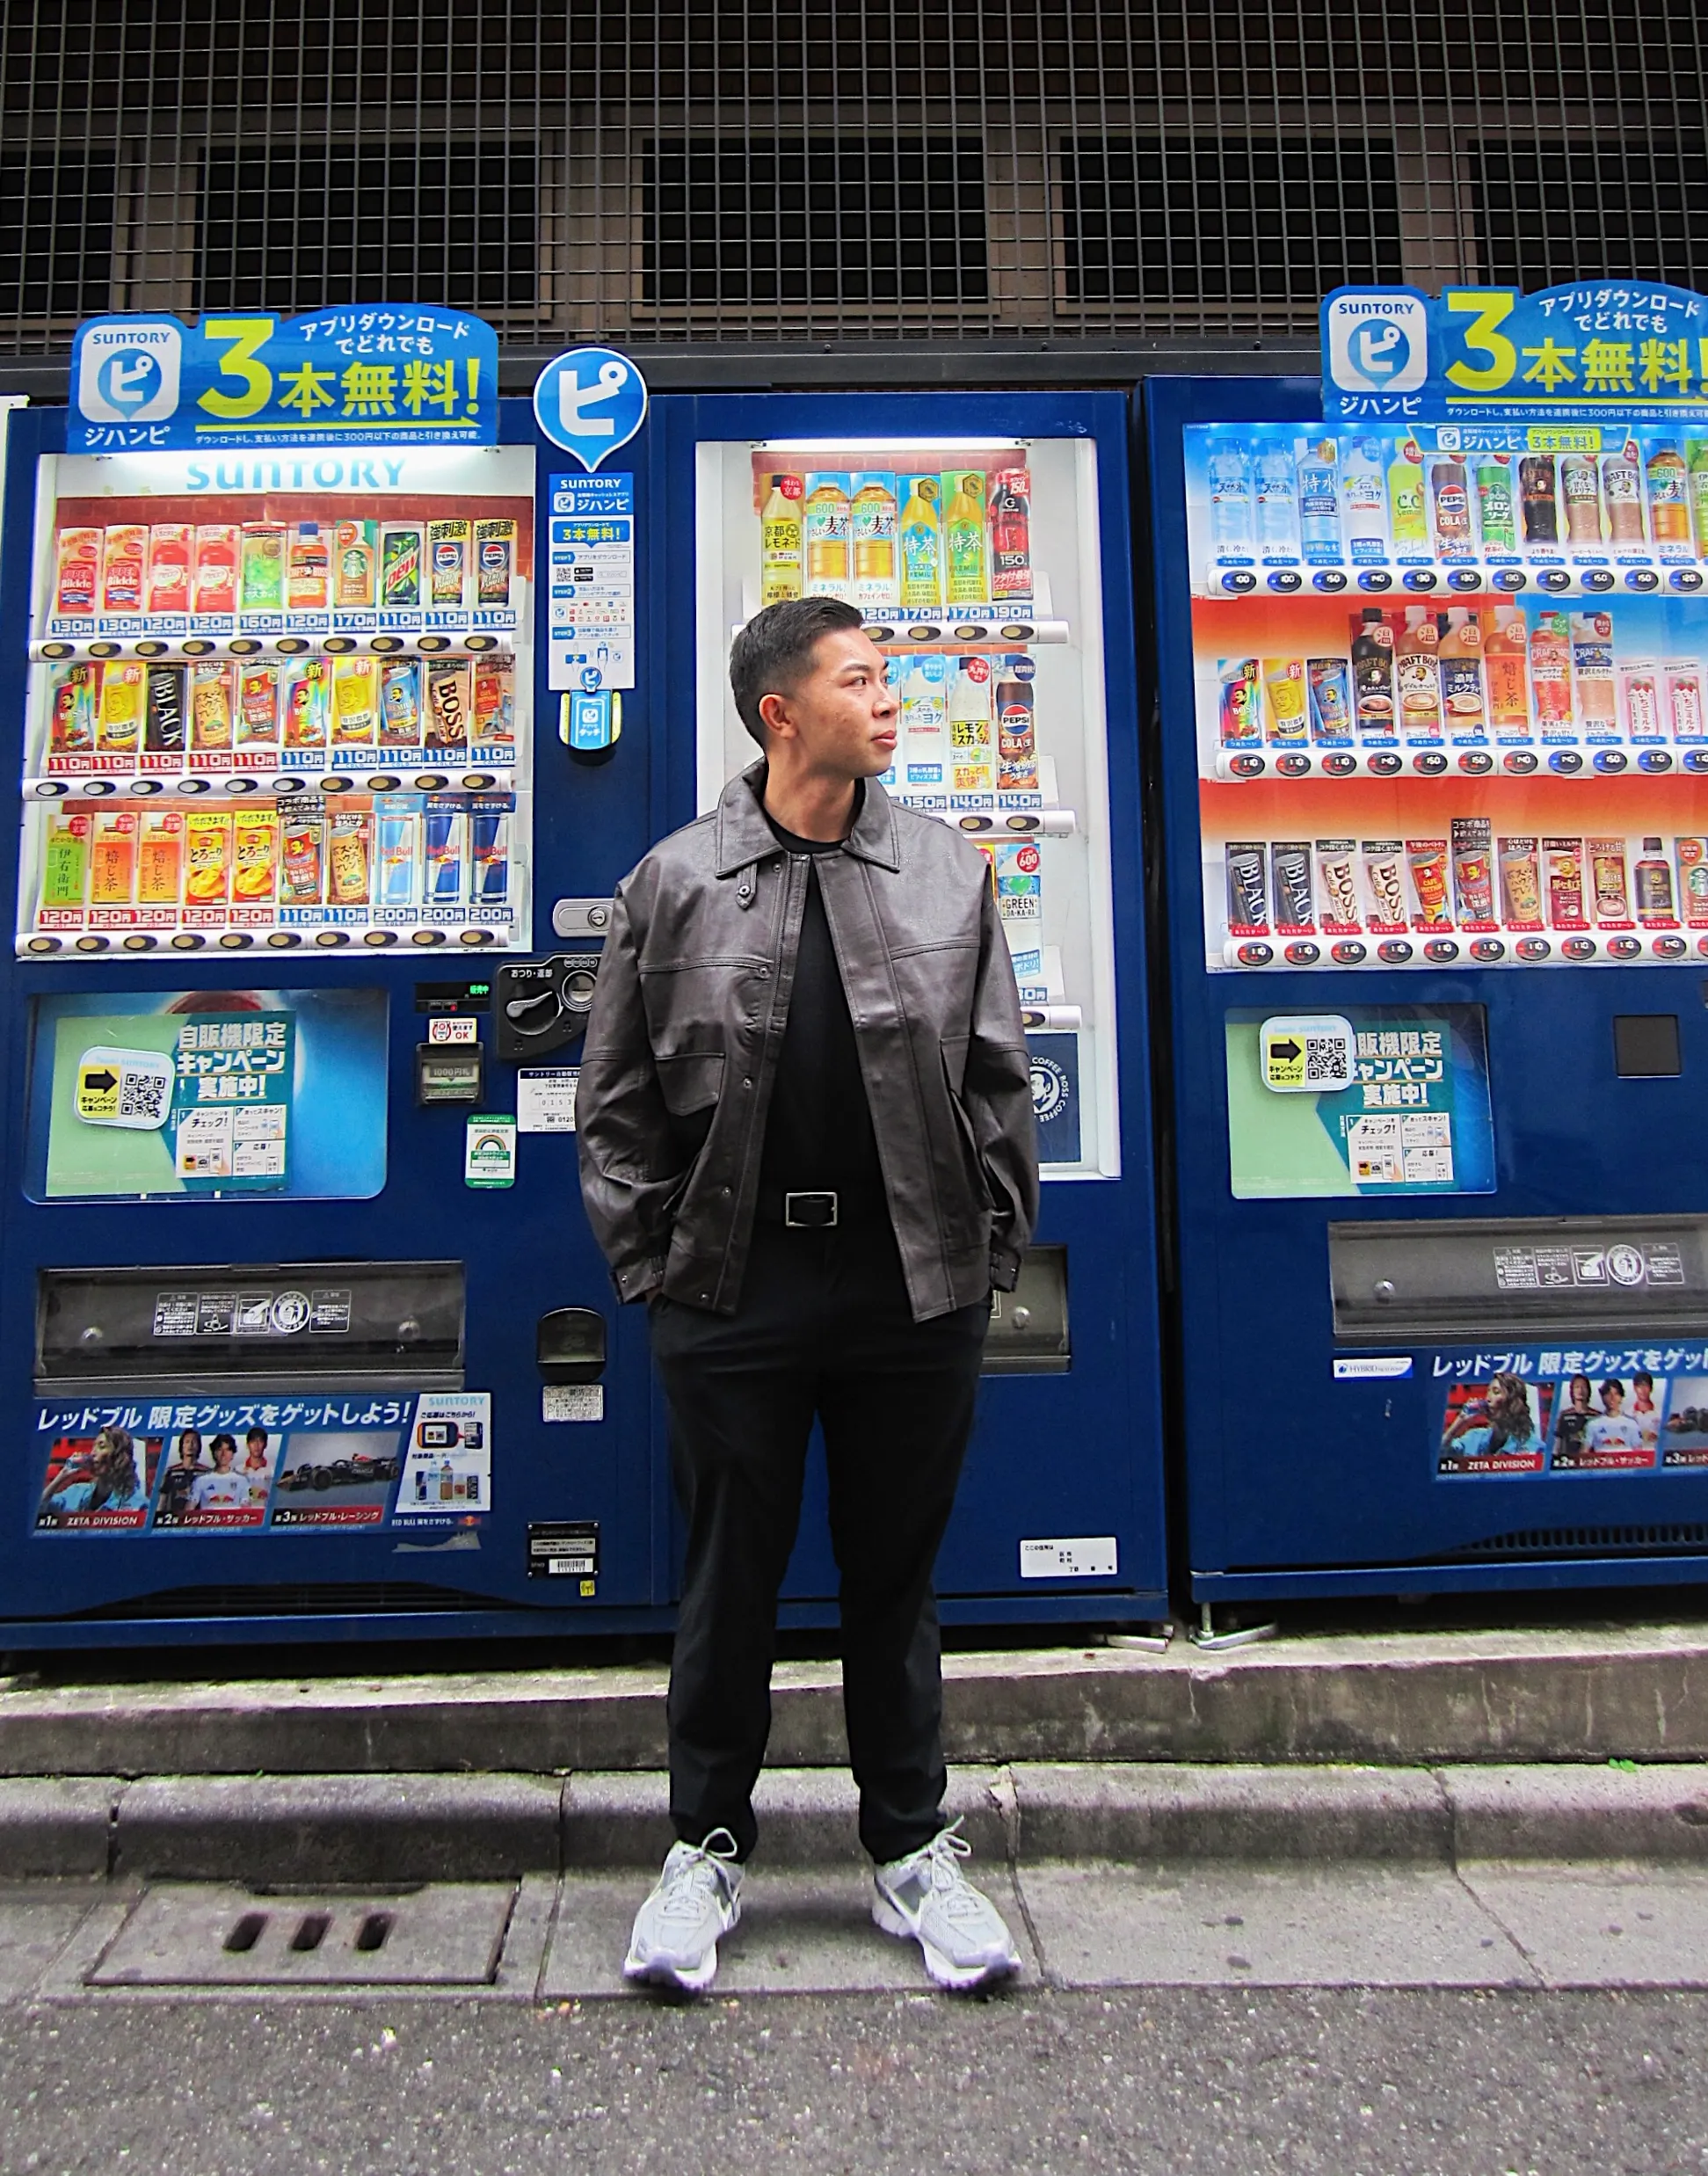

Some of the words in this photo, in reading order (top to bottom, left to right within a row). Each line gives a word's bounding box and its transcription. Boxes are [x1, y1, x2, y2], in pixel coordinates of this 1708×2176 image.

[1339, 302, 1414, 315] SUNTORY
[1539, 289, 1700, 318] アプリダウンロード
[300, 313, 470, 341] アプリダウンロード
[1574, 315, 1668, 333] でどれでも
[92, 331, 171, 346] SUNTORY
[335, 336, 434, 355] でどれでも
[1360, 326, 1399, 371] ピ
[112, 356, 153, 401] ピ
[559, 361, 628, 436] ピ
[1340, 397, 1422, 415] ジハンピ
[84, 426, 171, 447] ジハンピ
[1464, 435, 1520, 449] ジハンピ
[1532, 435, 1595, 450] 3本無料!
[187, 458, 406, 491] SUNTORY
[1657, 468, 1676, 478] 600
[561, 479, 621, 489] SUNTORY
[1303, 474, 1336, 492] 特水
[577, 499, 629, 511] ジハンピ
[815, 504, 834, 513] 600
[861, 503, 877, 513] 600
[1485, 501, 1510, 512] メロン
[1440, 516, 1461, 526] COLA
[563, 528, 621, 541] 3本無料!
[765, 526, 784, 537] 京都
[765, 538, 801, 549] レモネード
[904, 535, 936, 556] 特茶
[949, 531, 983, 552] 特茶
[336, 614, 375, 625] 170円
[382, 613, 422, 624] 110円
[427, 613, 468, 624] 110円
[475, 612, 514, 623] 110円
[902, 608, 941, 619] 170円
[960, 608, 990, 619] 170円
[992, 608, 1030, 619] 190円
[53, 619, 94, 631] 130円
[100, 618, 141, 630] 130円
[145, 617, 185, 630] 120円
[241, 616, 281, 628] 160円
[307, 662, 323, 679] 新
[355, 659, 370, 673] 新
[1288, 664, 1302, 677] 新
[71, 666, 87, 683] 新
[125, 667, 141, 682] 新
[1454, 673, 1474, 683] 濃厚
[1502, 662, 1520, 708] 焙じ茶
[155, 681, 183, 746] BLACK
[440, 680, 466, 740] BOSS
[957, 724, 983, 733] レモン
[1001, 738, 1022, 748] COLA
[51, 758, 91, 769] 110円
[95, 757, 134, 768] 110円
[905, 797, 946, 808] 150円
[952, 795, 992, 806] 140円
[999, 795, 1041, 806] 140円
[1019, 855, 1038, 867] 600
[57, 848, 71, 897] 伊右衛門
[104, 849, 120, 892] 焙じ茶
[151, 849, 165, 892] 焙じ茶
[1239, 861, 1267, 926] BLACK
[1285, 861, 1312, 926] BLACK
[1334, 861, 1358, 925] BOSS
[1379, 861, 1405, 925] BOSS
[1006, 898, 1035, 909] GREEN
[42, 910, 83, 923] 120円
[91, 910, 131, 922] 120円
[134, 909, 175, 921] 120円
[185, 909, 224, 921] 120円
[232, 909, 272, 921] 120円
[283, 909, 323, 921] 110円
[327, 909, 367, 921] 110円
[374, 909, 416, 921] 200円
[422, 909, 463, 921] 200円
[470, 909, 512, 921] 200円
[179, 1023, 287, 1049] 自販機限定
[455, 1031, 469, 1040] OK
[178, 1050, 285, 1073] キャンペーン
[1032, 1057, 1063, 1074] COFFEE
[198, 1074, 266, 1099] 実施中!
[1363, 1082, 1428, 1105] 実施中!
[1039, 1100, 1066, 1123] COFFEE
[191, 1117, 229, 1128] チェック!
[1361, 1125, 1396, 1135] チェック!
[1432, 1354, 1532, 1377] レッドブル
[429, 1396, 485, 1406] SUNTORY
[37, 1407, 142, 1431] レッドブル
[148, 1401, 411, 1430] 限定グッズをゲットしよう!
[1468, 1461, 1490, 1471] ZETA
[1493, 1459, 1536, 1469] DIVISION
[67, 1517, 89, 1526] ZETA
[92, 1516, 137, 1525] DIVISION
[184, 1514, 257, 1525] レッドブル・サッカー
[300, 1510, 380, 1523] レッドブル・レーシング
